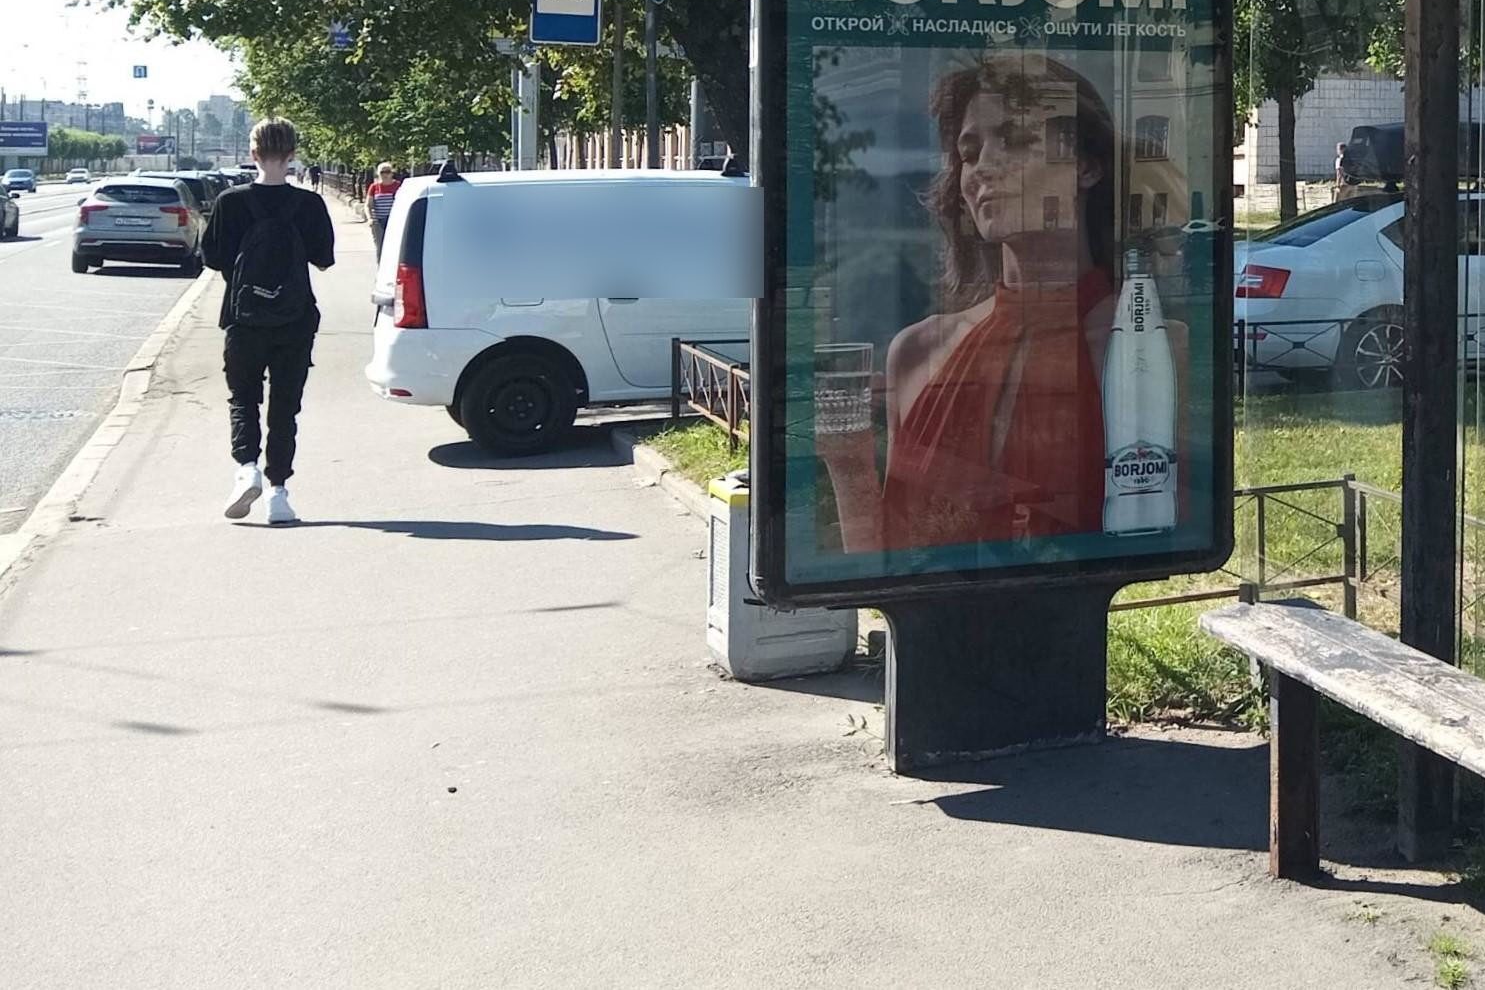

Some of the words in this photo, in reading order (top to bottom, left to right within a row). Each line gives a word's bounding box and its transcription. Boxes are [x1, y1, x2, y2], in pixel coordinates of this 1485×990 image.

[811, 15, 884, 31] ОТКРОЙ
[913, 19, 1017, 35] НАСЛАДИСЬ
[1043, 21, 1102, 37] ОЩУТИ
[1106, 23, 1186, 37] ЛЕГКОСТЬ
[1134, 282, 1145, 332] BORJOMI
[1114, 461, 1167, 477] BORJOMI
